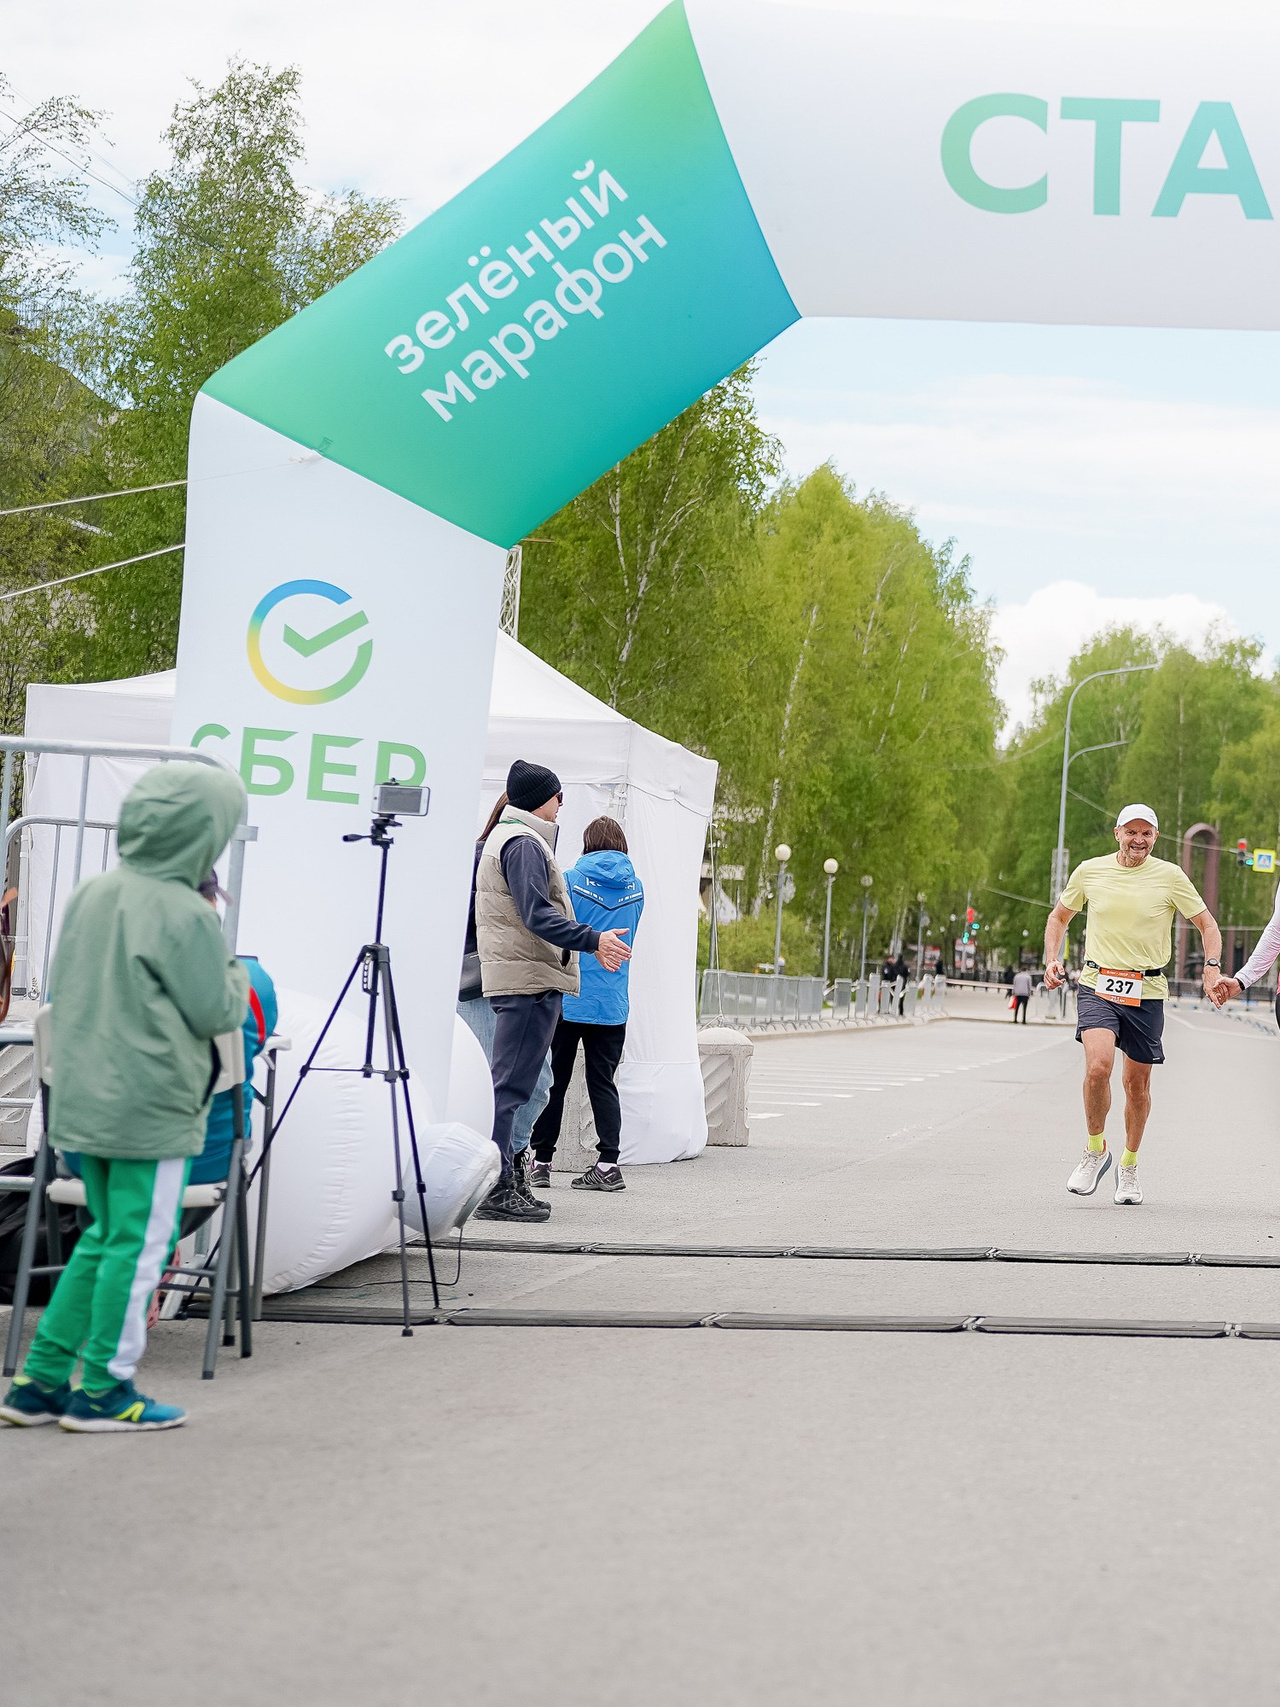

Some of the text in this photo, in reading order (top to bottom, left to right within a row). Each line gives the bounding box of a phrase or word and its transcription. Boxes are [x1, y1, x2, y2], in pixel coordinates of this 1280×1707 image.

[384, 159, 629, 375] зелёный
[421, 214, 668, 422] марафон
[1105, 978, 1134, 995] 237
